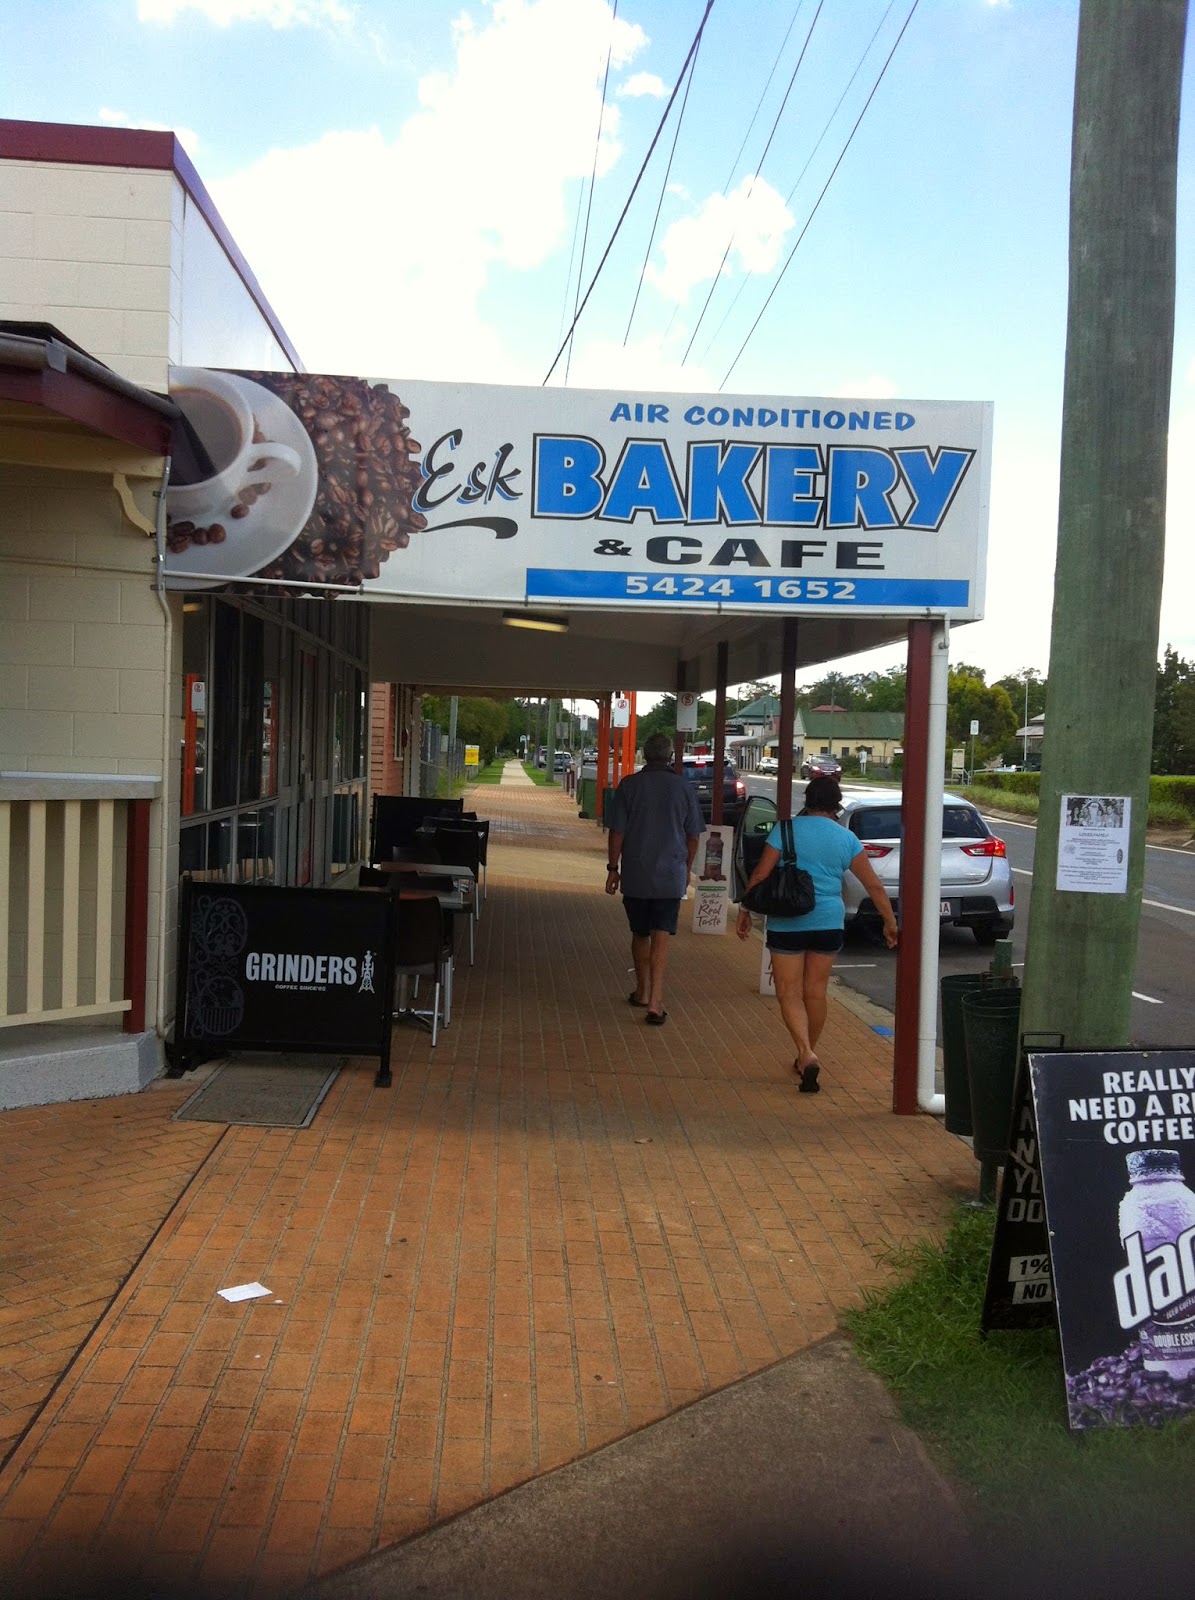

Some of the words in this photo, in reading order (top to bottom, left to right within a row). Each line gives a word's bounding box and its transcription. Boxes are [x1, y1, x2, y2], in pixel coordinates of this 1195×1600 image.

[609, 402, 669, 425] AIR
[684, 405, 916, 432] CONDITIONED
[413, 428, 524, 513] Esk
[530, 432, 977, 532] BAKERY
[593, 538, 632, 557] &
[646, 536, 885, 570] CAFE
[626, 575, 734, 598] 5424
[754, 579, 857, 600] 1652
[696, 915, 721, 927] Taste
[698, 904, 722, 916] Real
[246, 952, 357, 985] GRINDERS
[1103, 1067, 1195, 1094] REALLY
[1068, 1096, 1136, 1121] NEED
[1145, 1094, 1165, 1117] A
[1172, 1091, 1195, 1115] R
